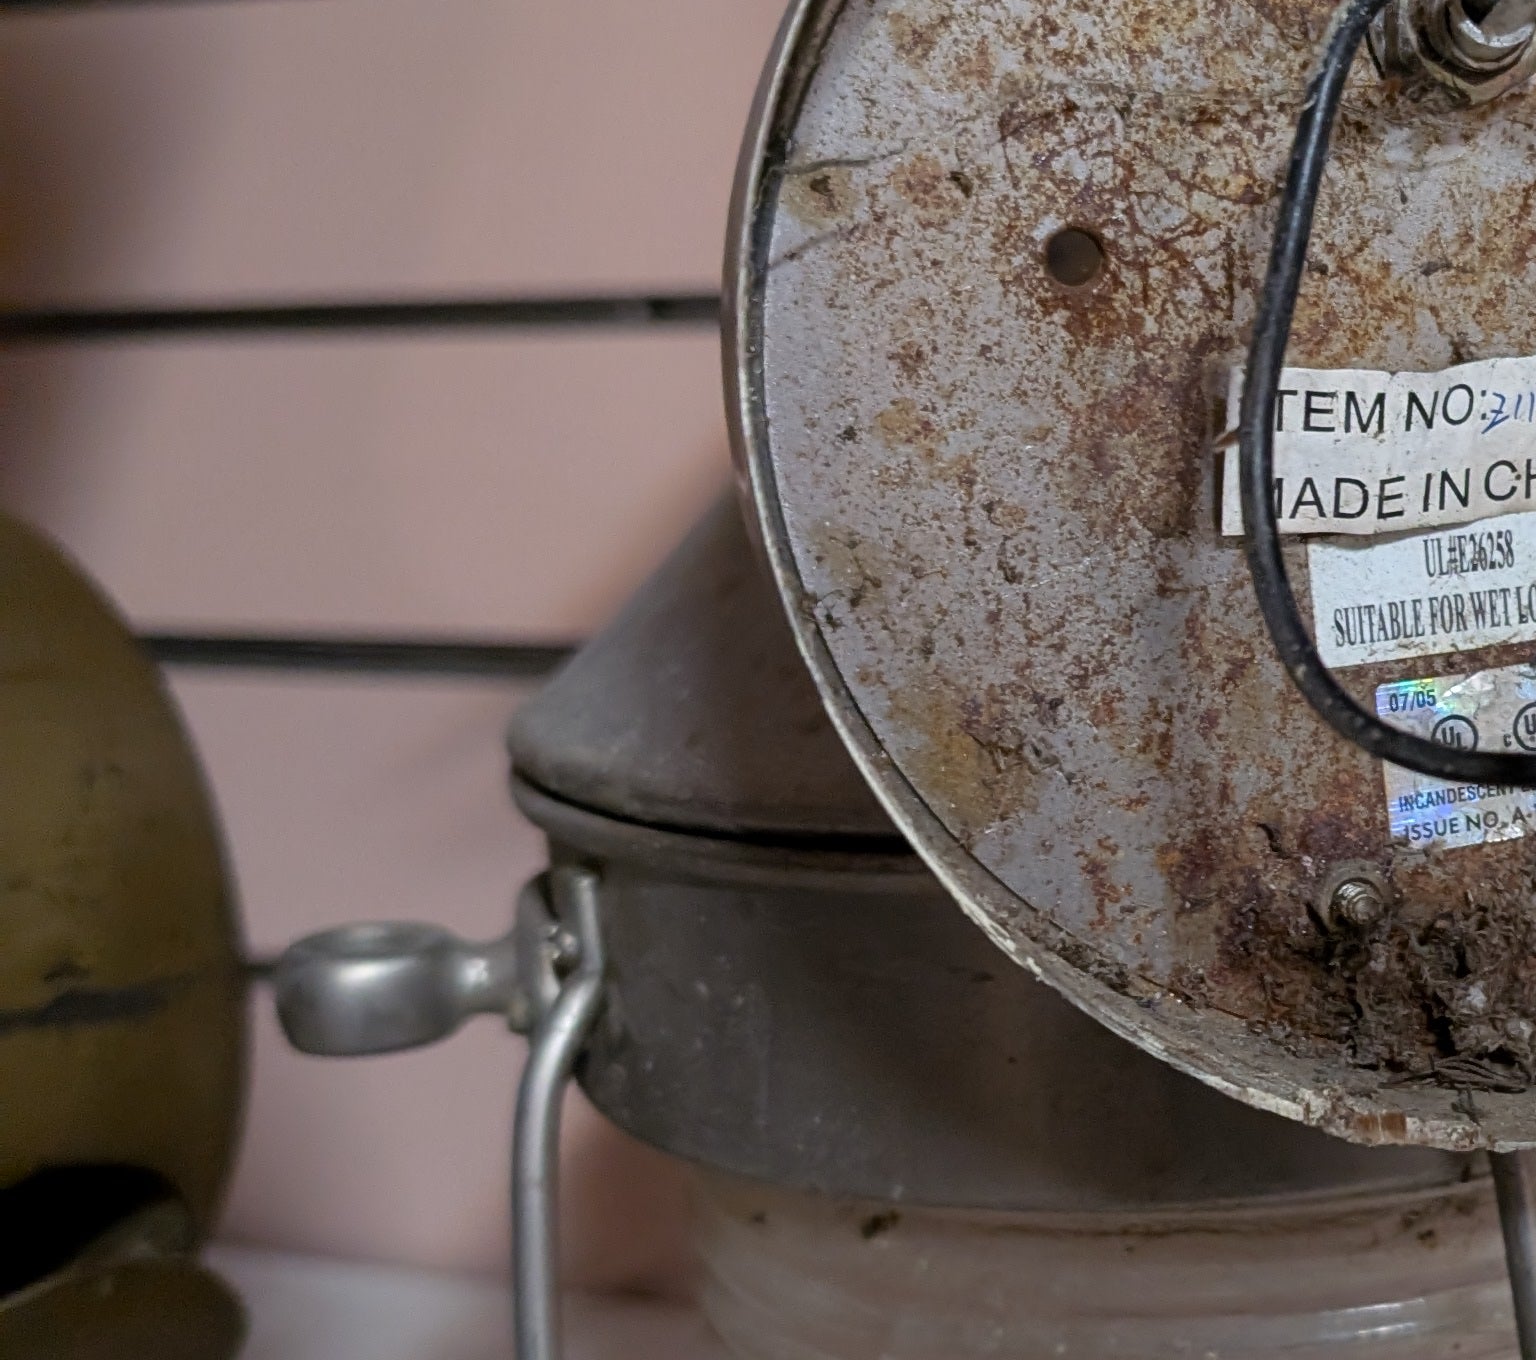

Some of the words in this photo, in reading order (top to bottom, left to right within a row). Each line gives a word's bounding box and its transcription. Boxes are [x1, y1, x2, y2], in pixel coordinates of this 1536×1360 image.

[1275, 388, 1386, 434] TEM
[1273, 475, 1406, 520] ADE
[1422, 466, 1471, 513] IN
[1333, 597, 1426, 648] SUITABLE
[1429, 594, 1468, 636] FOR
[1469, 587, 1513, 631] WET
[1388, 688, 1438, 712] 07/05
[1404, 816, 1461, 841] ISSUE
